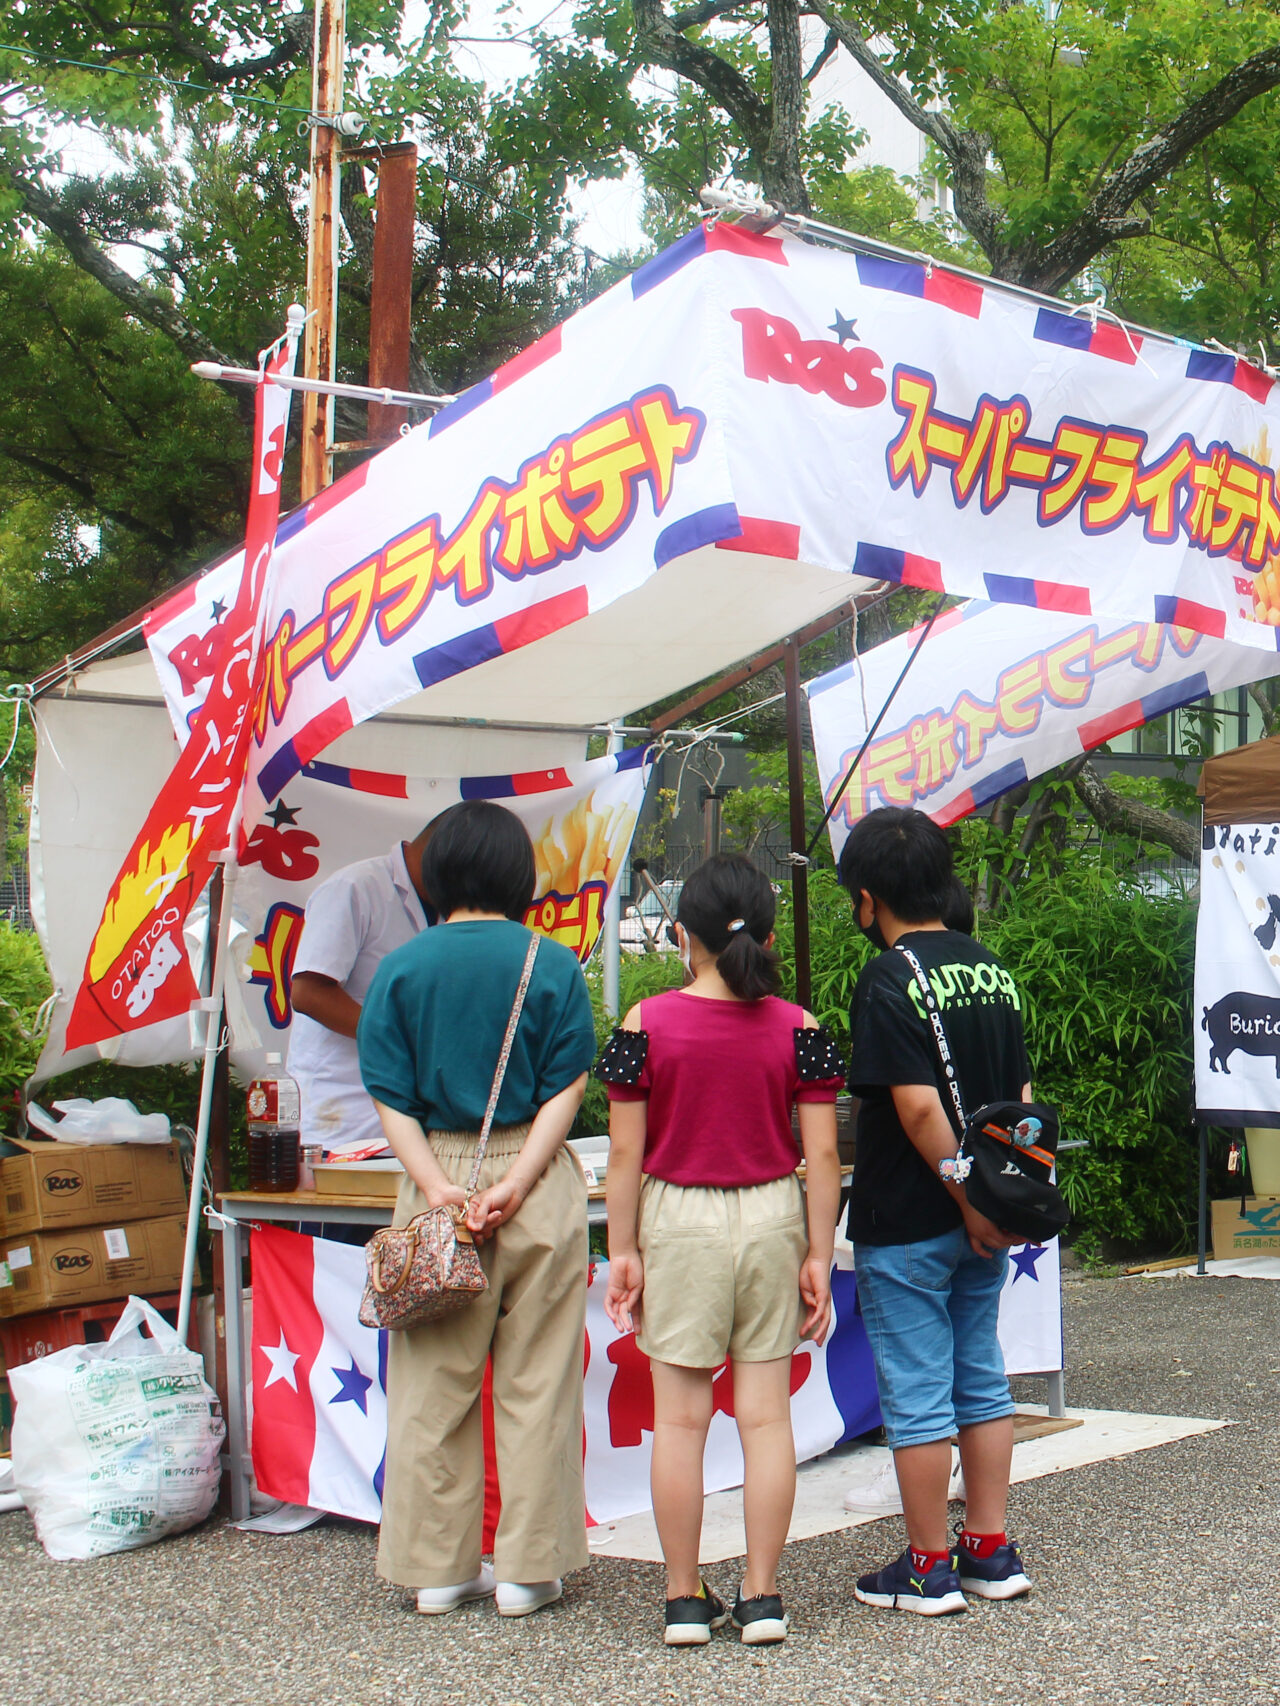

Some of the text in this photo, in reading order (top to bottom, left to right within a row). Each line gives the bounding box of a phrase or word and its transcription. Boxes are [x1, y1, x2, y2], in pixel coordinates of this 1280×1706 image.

[250, 386, 706, 748] パーフライポテト
[903, 949, 930, 994] DICKIES
[907, 962, 1021, 1020] OUTDOOR
[946, 994, 1011, 1011] PROUCTS
[929, 1011, 951, 1064] DICKIES
[46, 1176, 82, 1192] Ras
[55, 1255, 92, 1272] Ras
[963, 1534, 983, 1550] 17
[912, 1552, 928, 1568] 17
